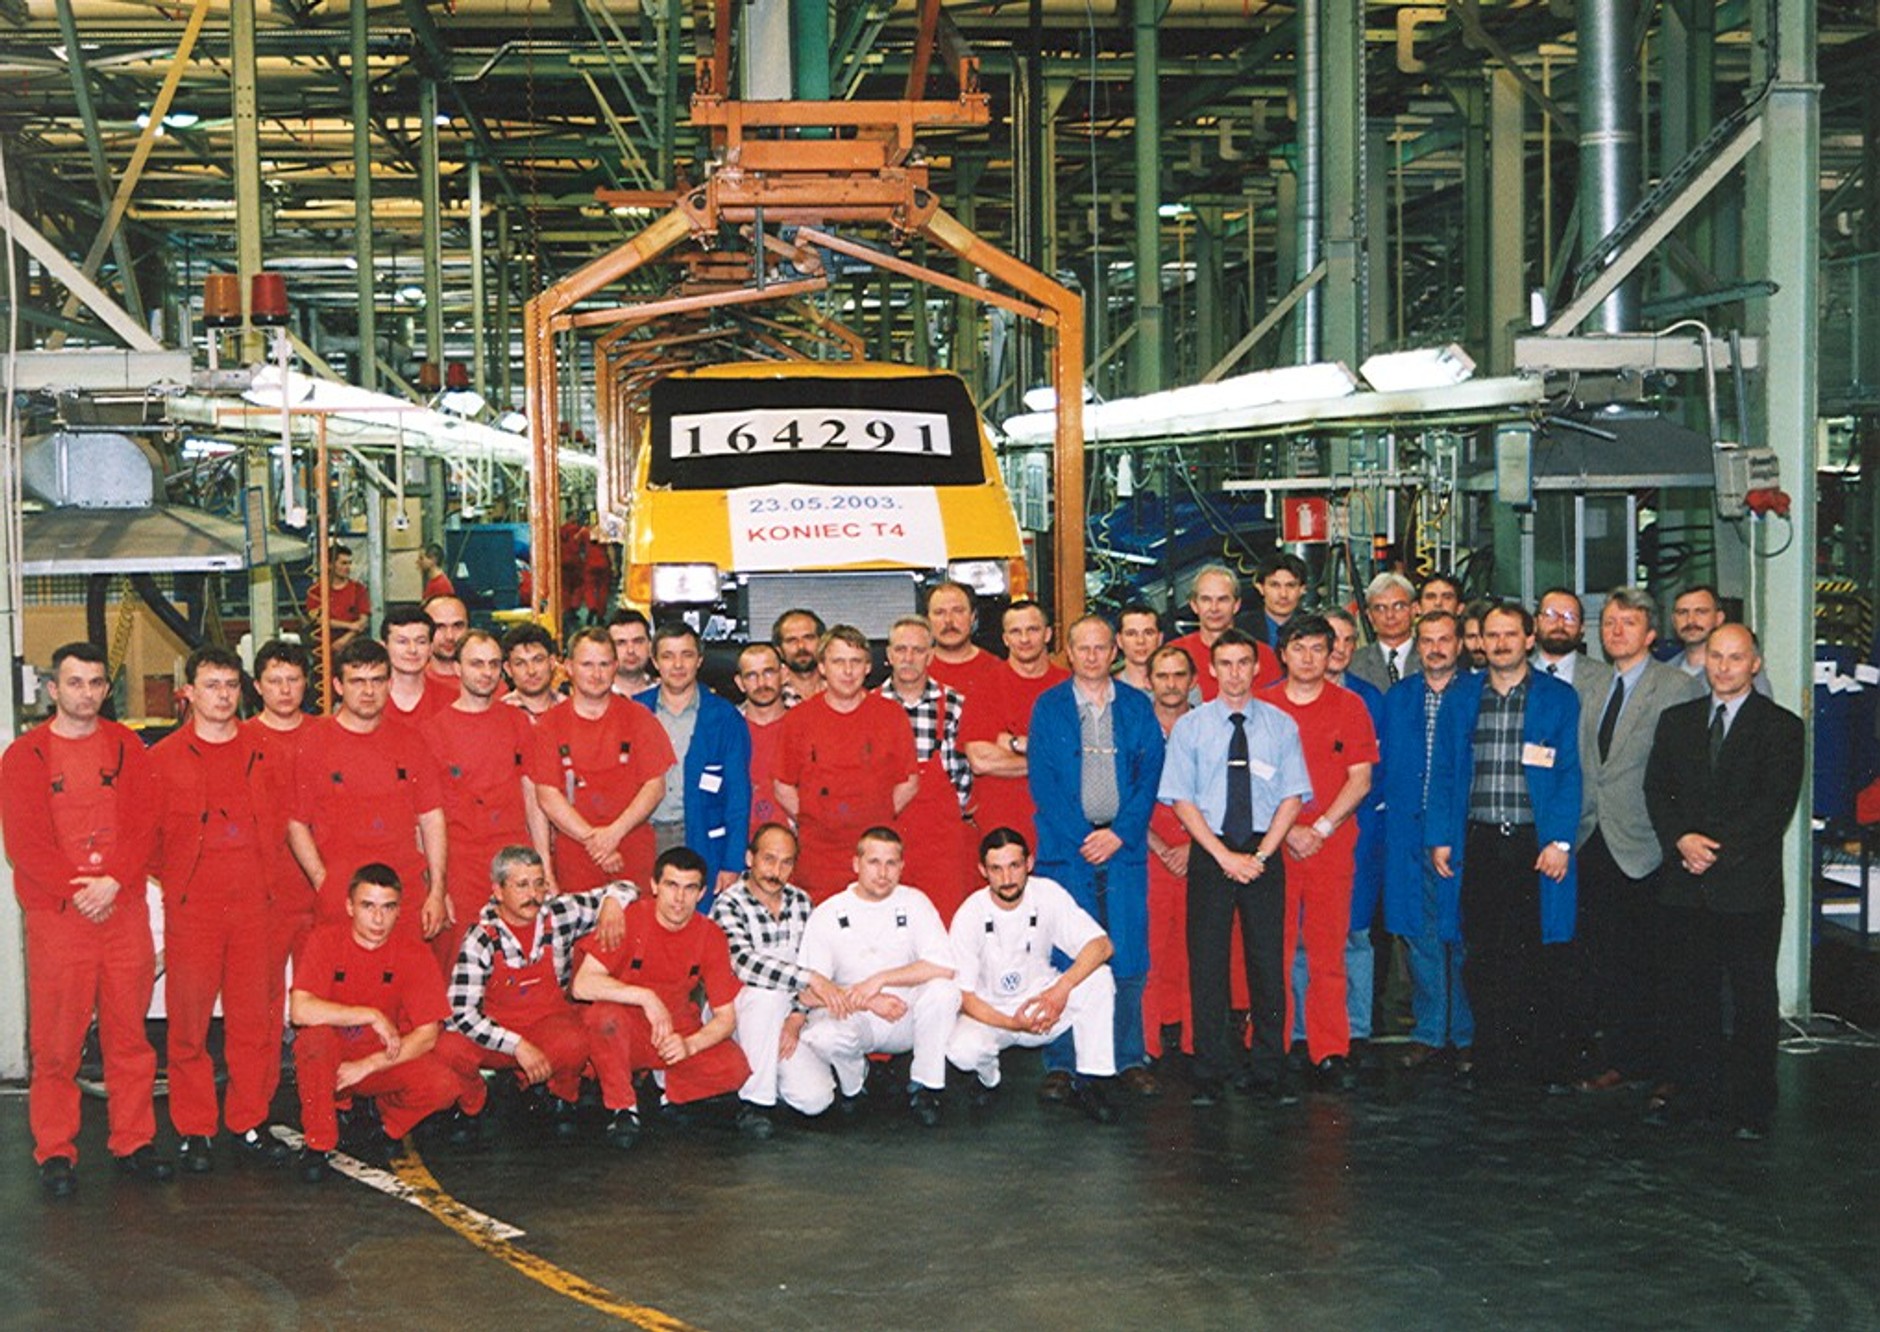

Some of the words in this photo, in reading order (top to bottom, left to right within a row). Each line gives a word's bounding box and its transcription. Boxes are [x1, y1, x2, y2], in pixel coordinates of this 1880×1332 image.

[686, 418, 935, 454] 164291
[749, 495, 904, 514] 23.05.2003.
[747, 522, 862, 542] KONIEC
[871, 521, 905, 538] T4
